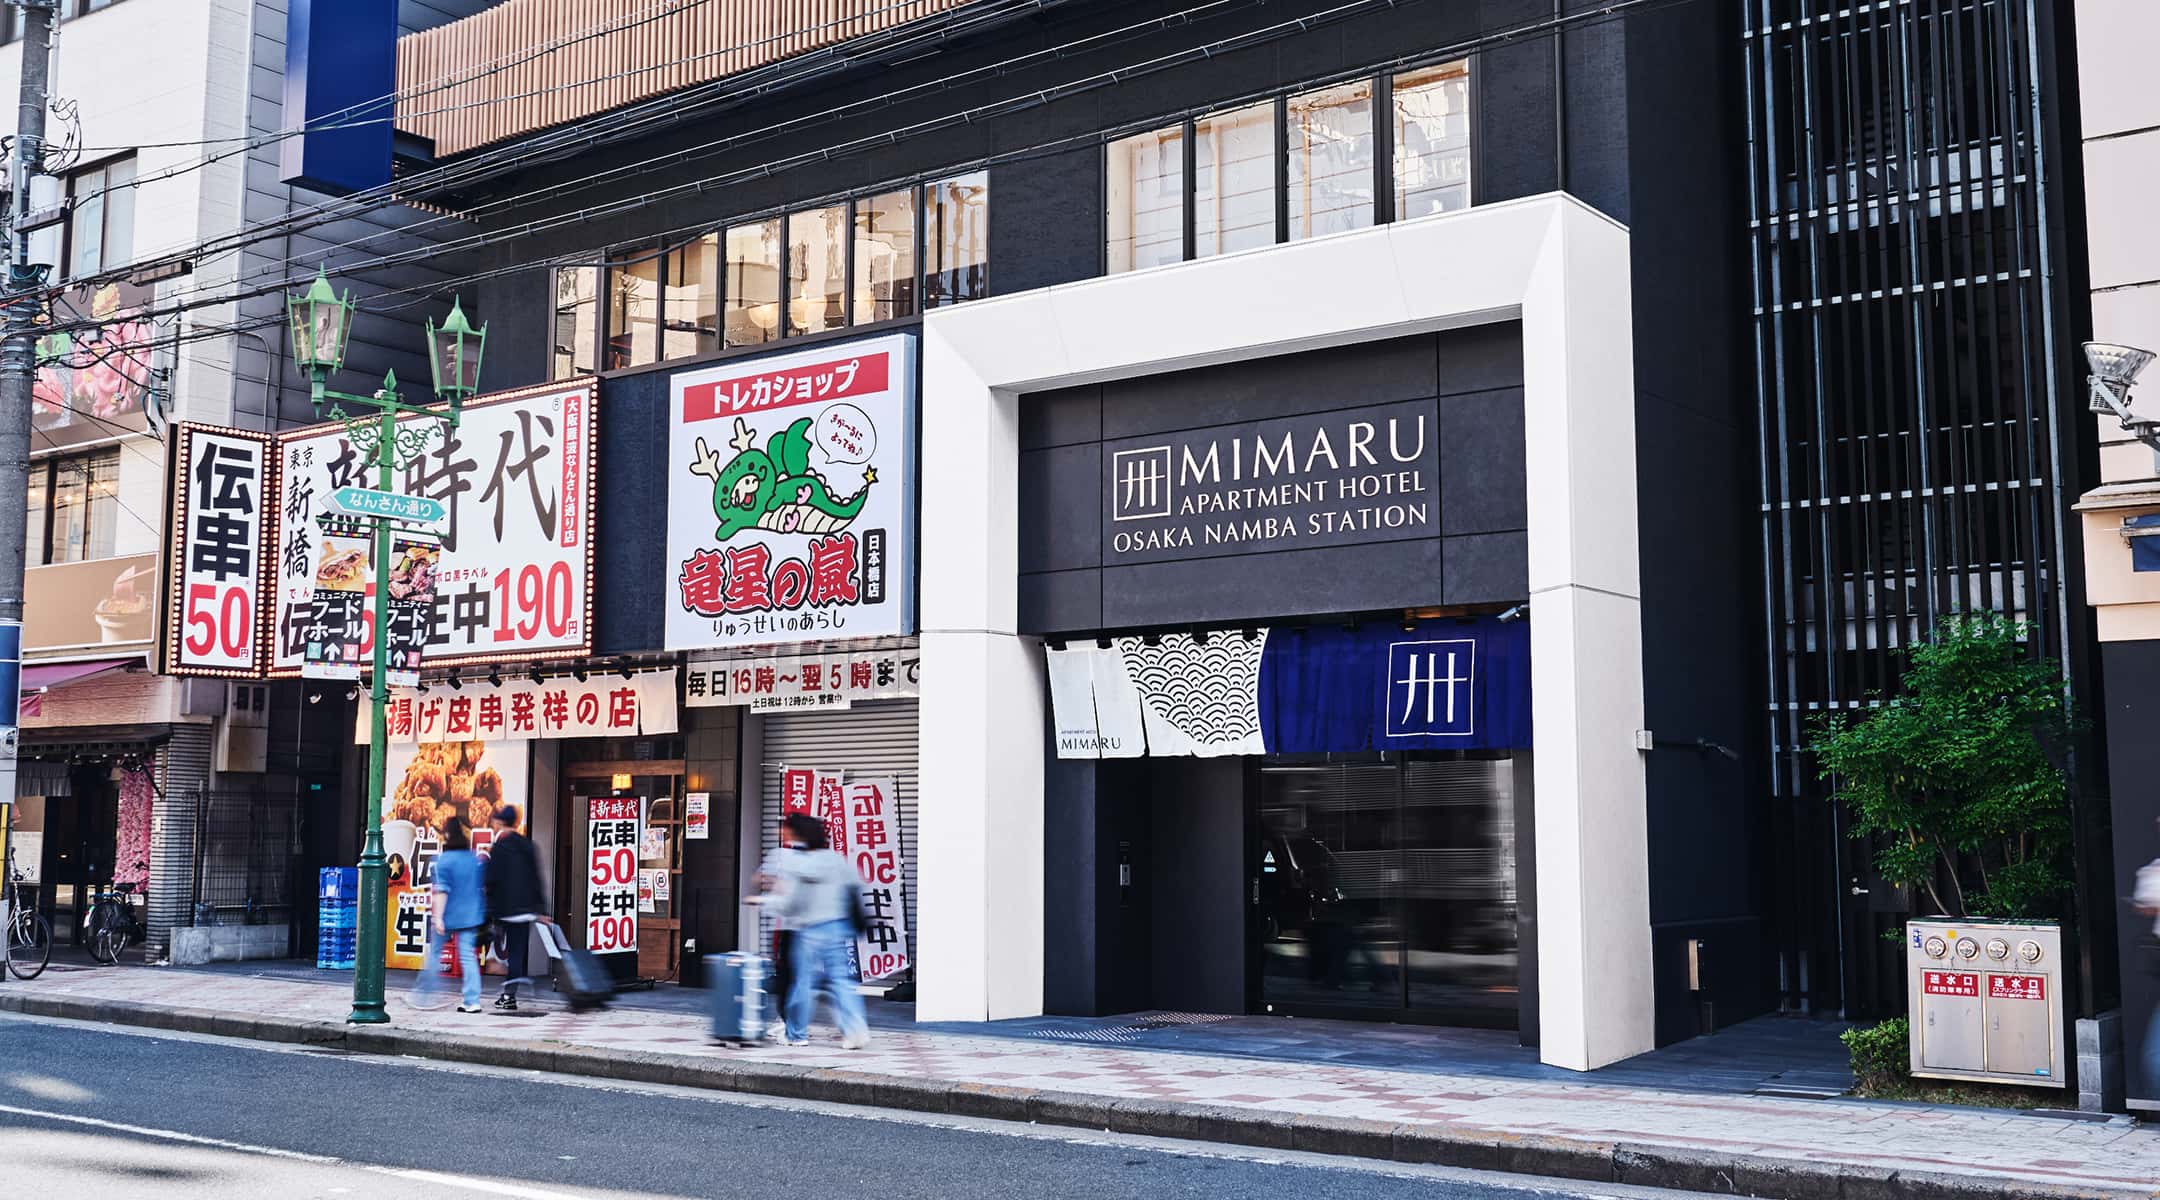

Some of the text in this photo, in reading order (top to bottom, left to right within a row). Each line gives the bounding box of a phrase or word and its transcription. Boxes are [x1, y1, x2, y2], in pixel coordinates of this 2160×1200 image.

[714, 359, 859, 414] トレカショップ
[1180, 415, 1425, 486] MIMARU
[349, 492, 432, 516] なんさん通り
[1180, 471, 1426, 515] APARTMENT HOTEL
[195, 442, 255, 582] 伝串
[1114, 503, 1427, 553] OSAKA NAMBA STATION
[679, 533, 859, 616] 竜星の嵐
[867, 535, 881, 598] 日本橋店
[312, 600, 361, 620] フード
[313, 591, 365, 600] コミュニティー
[387, 600, 430, 609] ミュニティー
[308, 621, 361, 641] ホール
[713, 609, 845, 638] りゅうせいのあらし
[388, 686, 636, 737] 揚げ皮串発祥の店
[1061, 737, 1121, 750] MIMARU
[597, 799, 639, 819] 新時代
[592, 820, 635, 848] 伝串
[590, 889, 635, 918] 生中
[396, 906, 432, 953] 生
[1994, 977, 2038, 989] 送水口
